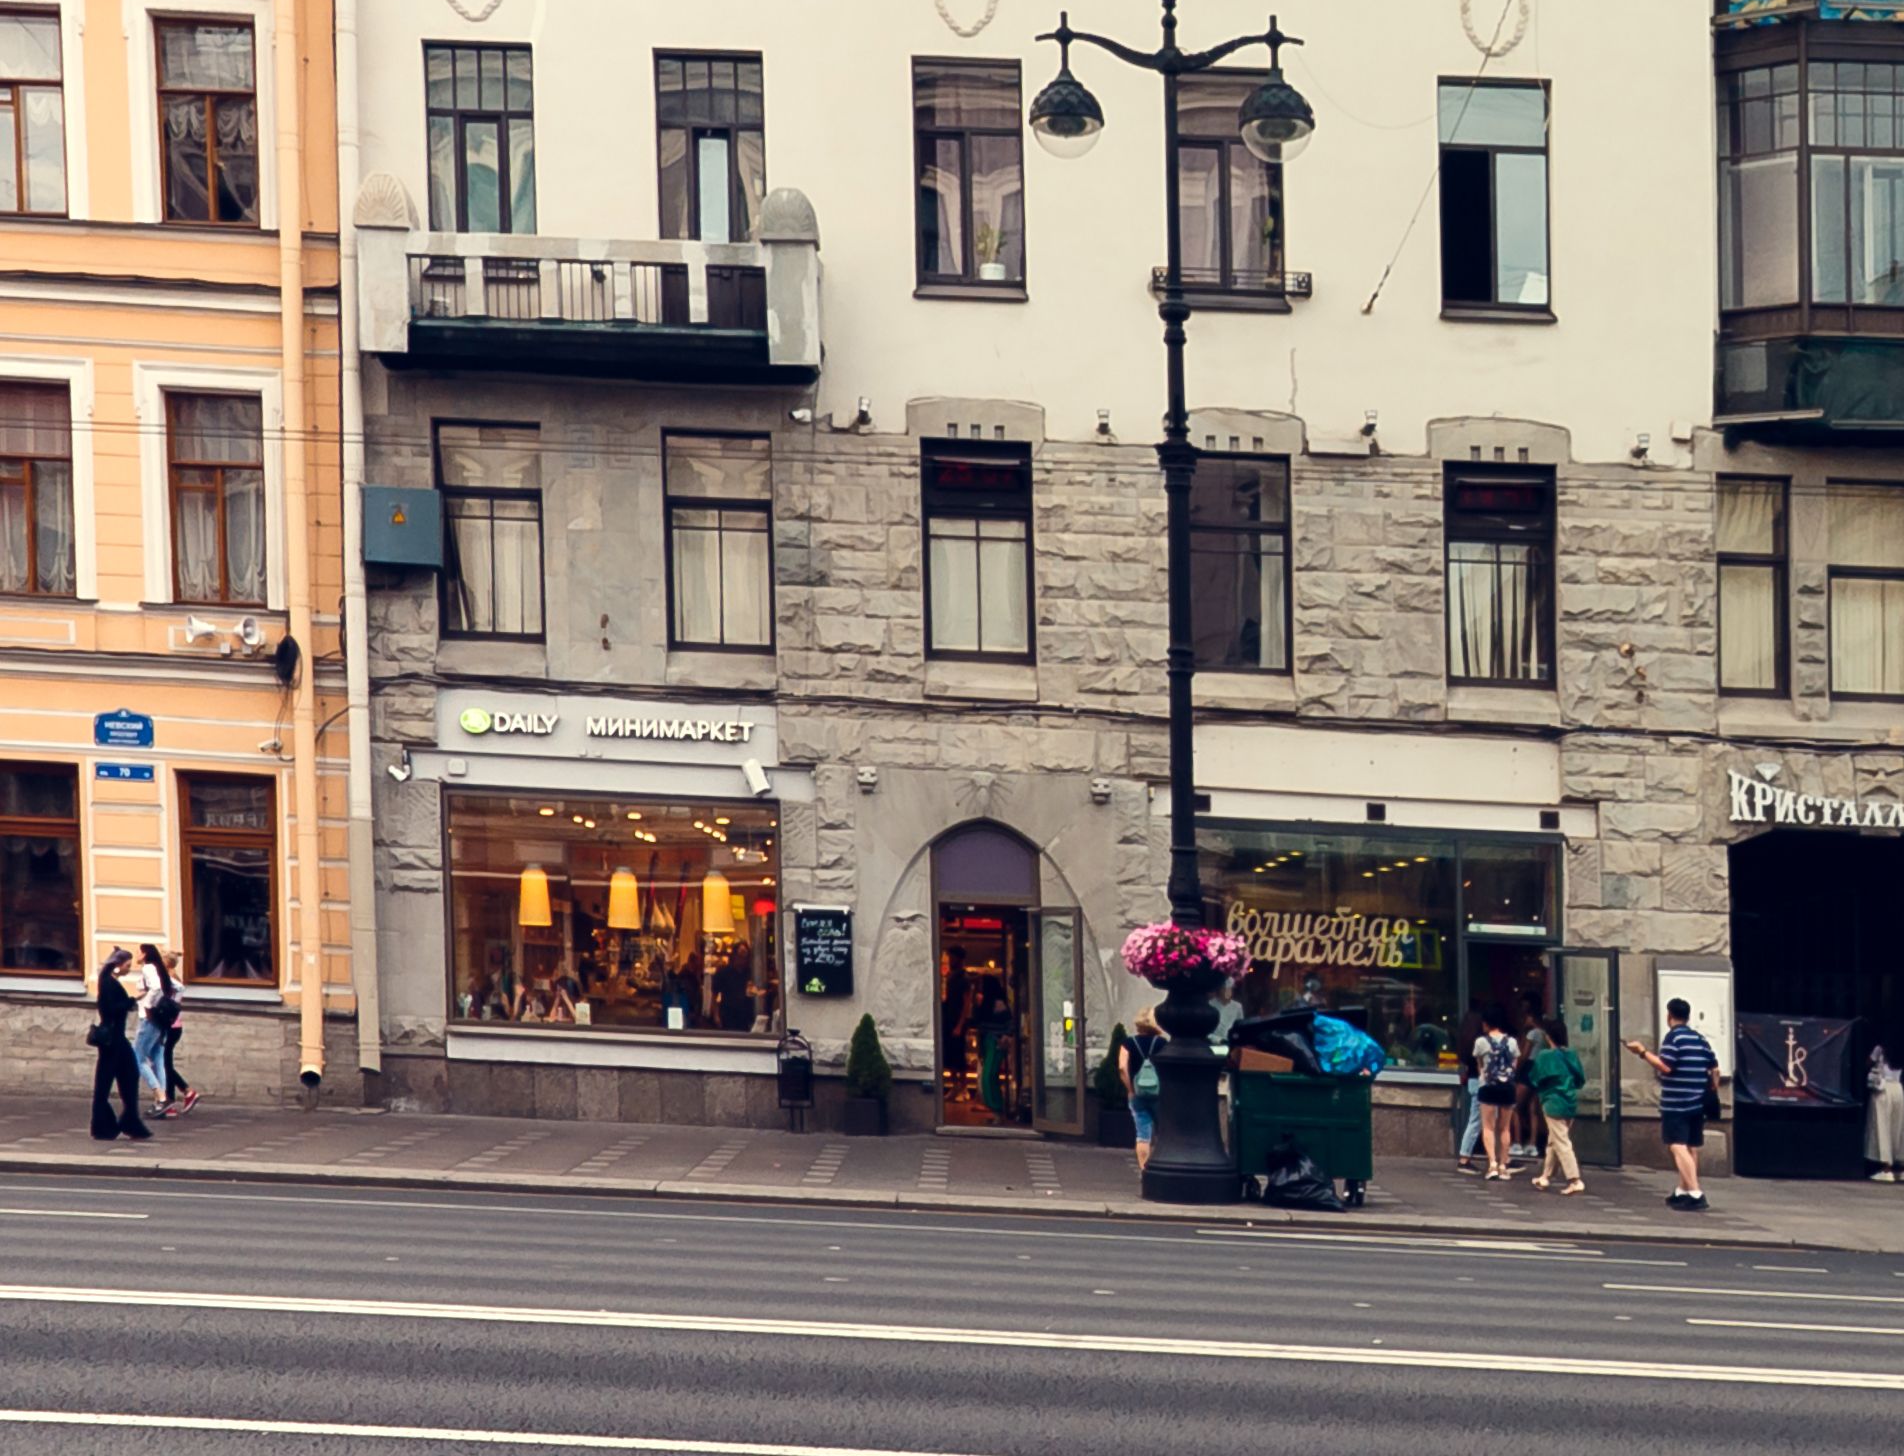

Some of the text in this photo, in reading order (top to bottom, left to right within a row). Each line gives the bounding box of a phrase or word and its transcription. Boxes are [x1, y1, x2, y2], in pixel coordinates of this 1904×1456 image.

[493, 711, 559, 734] DAILY
[586, 715, 755, 742] МИНИМАРКЕТ
[119, 767, 131, 778] 70
[1226, 900, 1415, 945] волшебная
